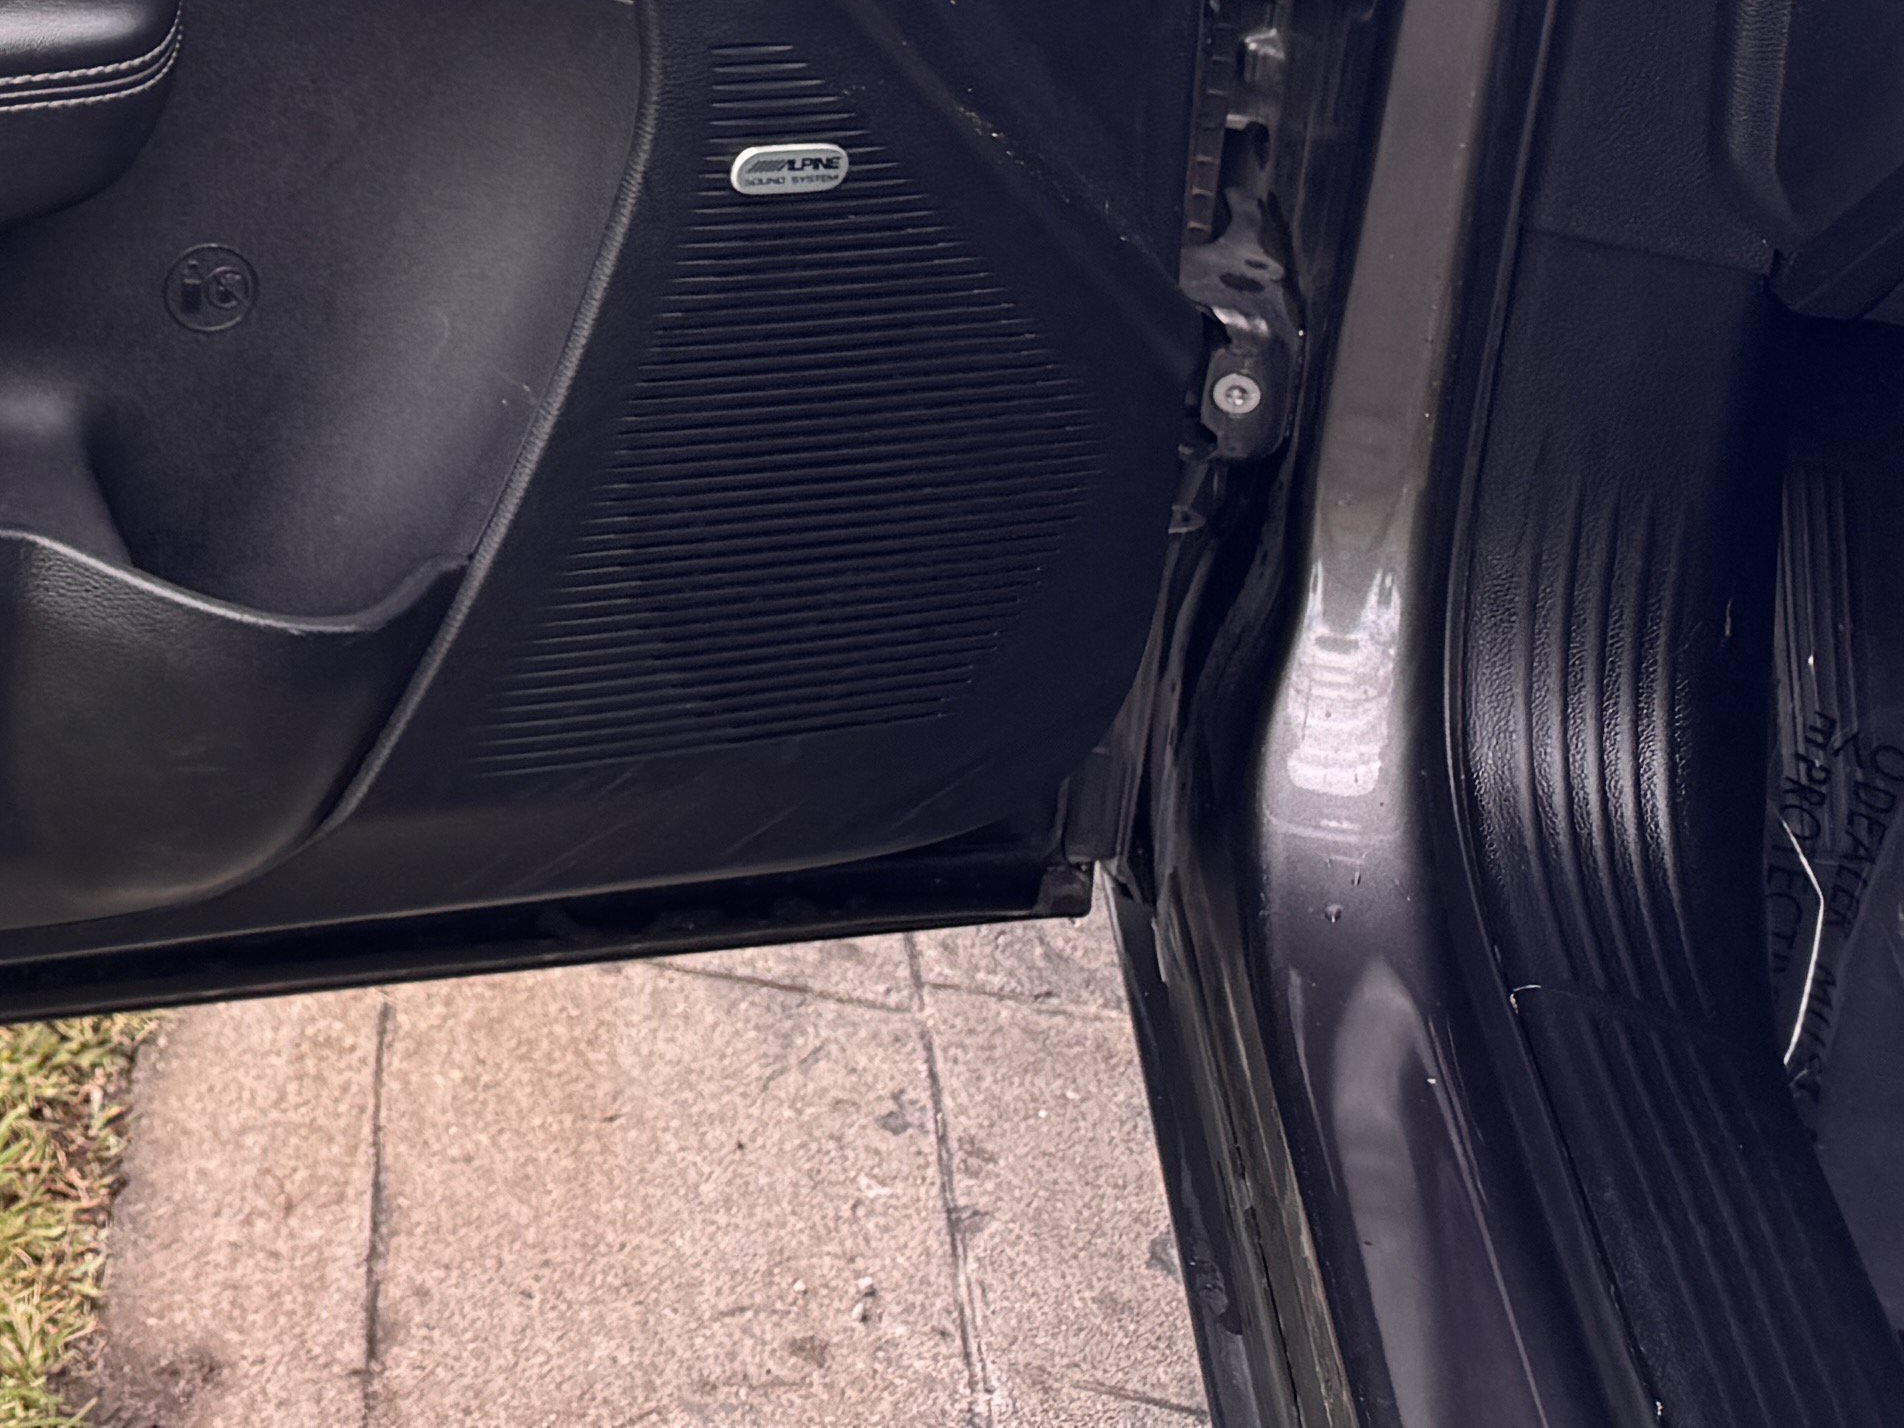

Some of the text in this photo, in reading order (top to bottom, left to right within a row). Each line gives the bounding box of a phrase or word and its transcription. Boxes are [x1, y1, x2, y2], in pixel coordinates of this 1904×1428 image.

[778, 157, 842, 171] ALPINE
[792, 174, 839, 183] SYSTEM
[1823, 777, 1896, 940] DEALER
